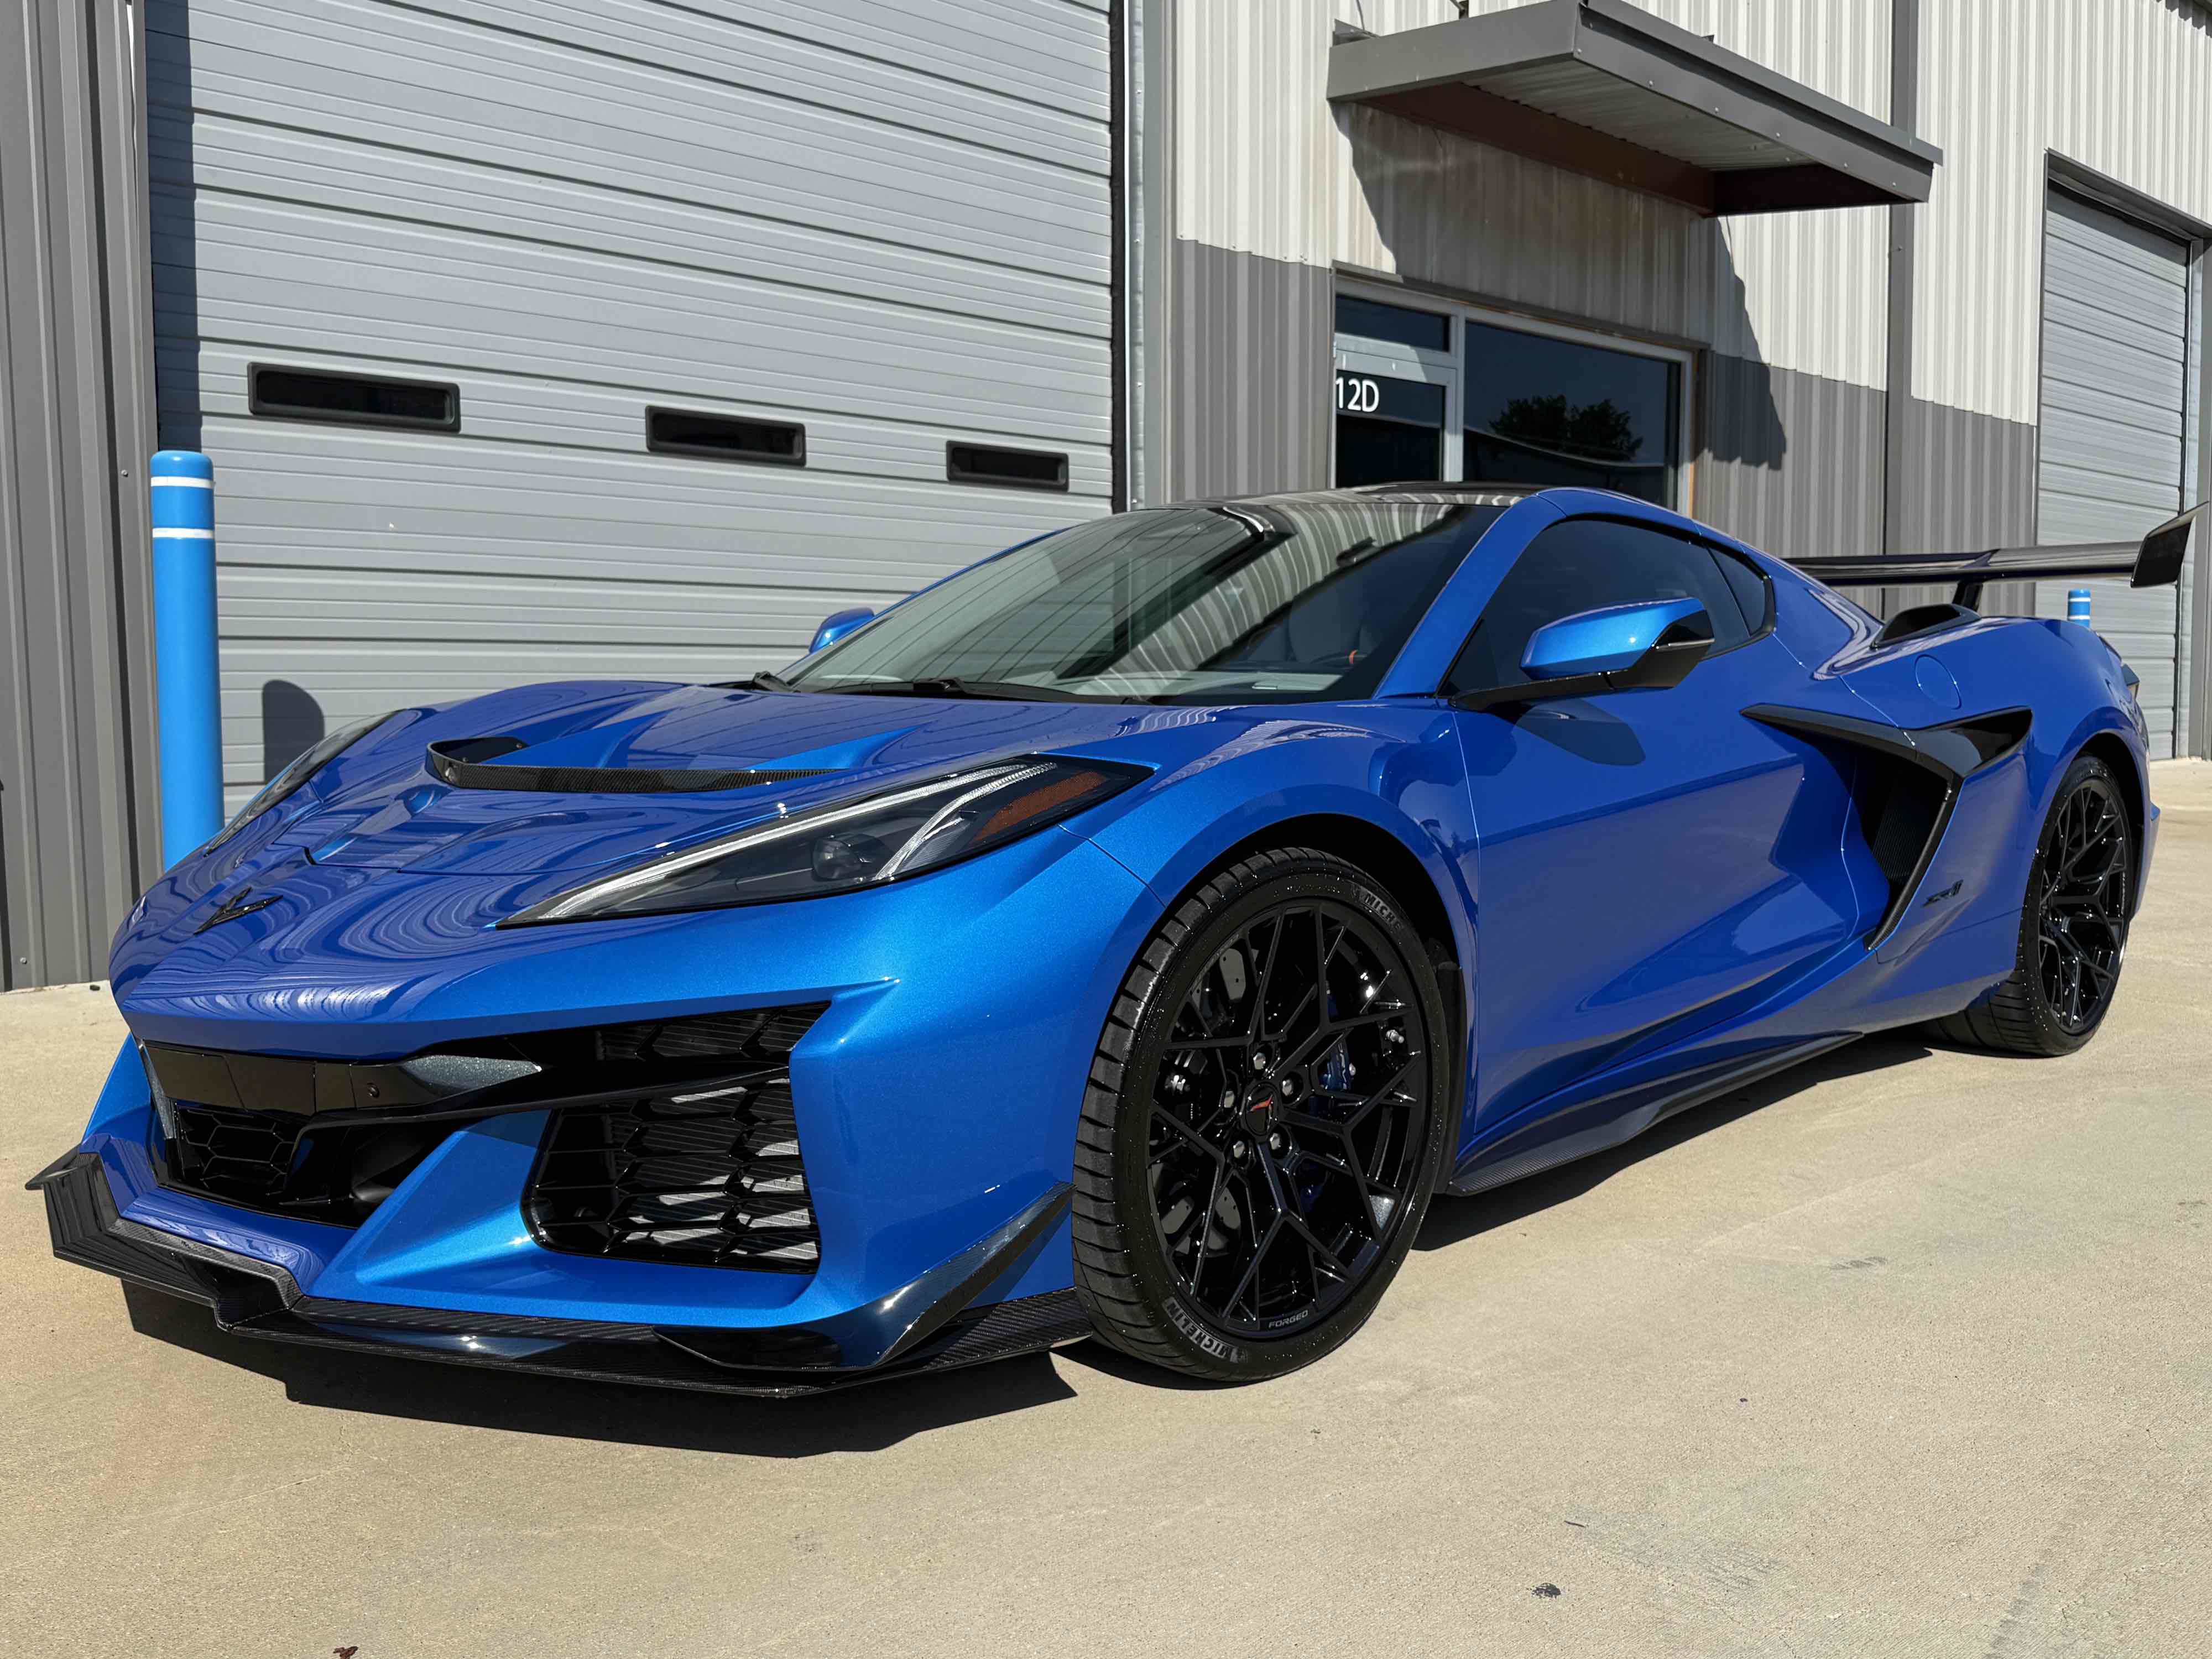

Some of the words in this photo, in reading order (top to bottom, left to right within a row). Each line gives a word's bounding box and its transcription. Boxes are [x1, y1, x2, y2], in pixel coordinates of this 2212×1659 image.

[1336, 377, 1379, 412] 12D
[1364, 893, 1402, 928] MICHE
[1166, 1301, 1234, 1357] MICHELIN
[1268, 1309, 1309, 1328] FORGED
